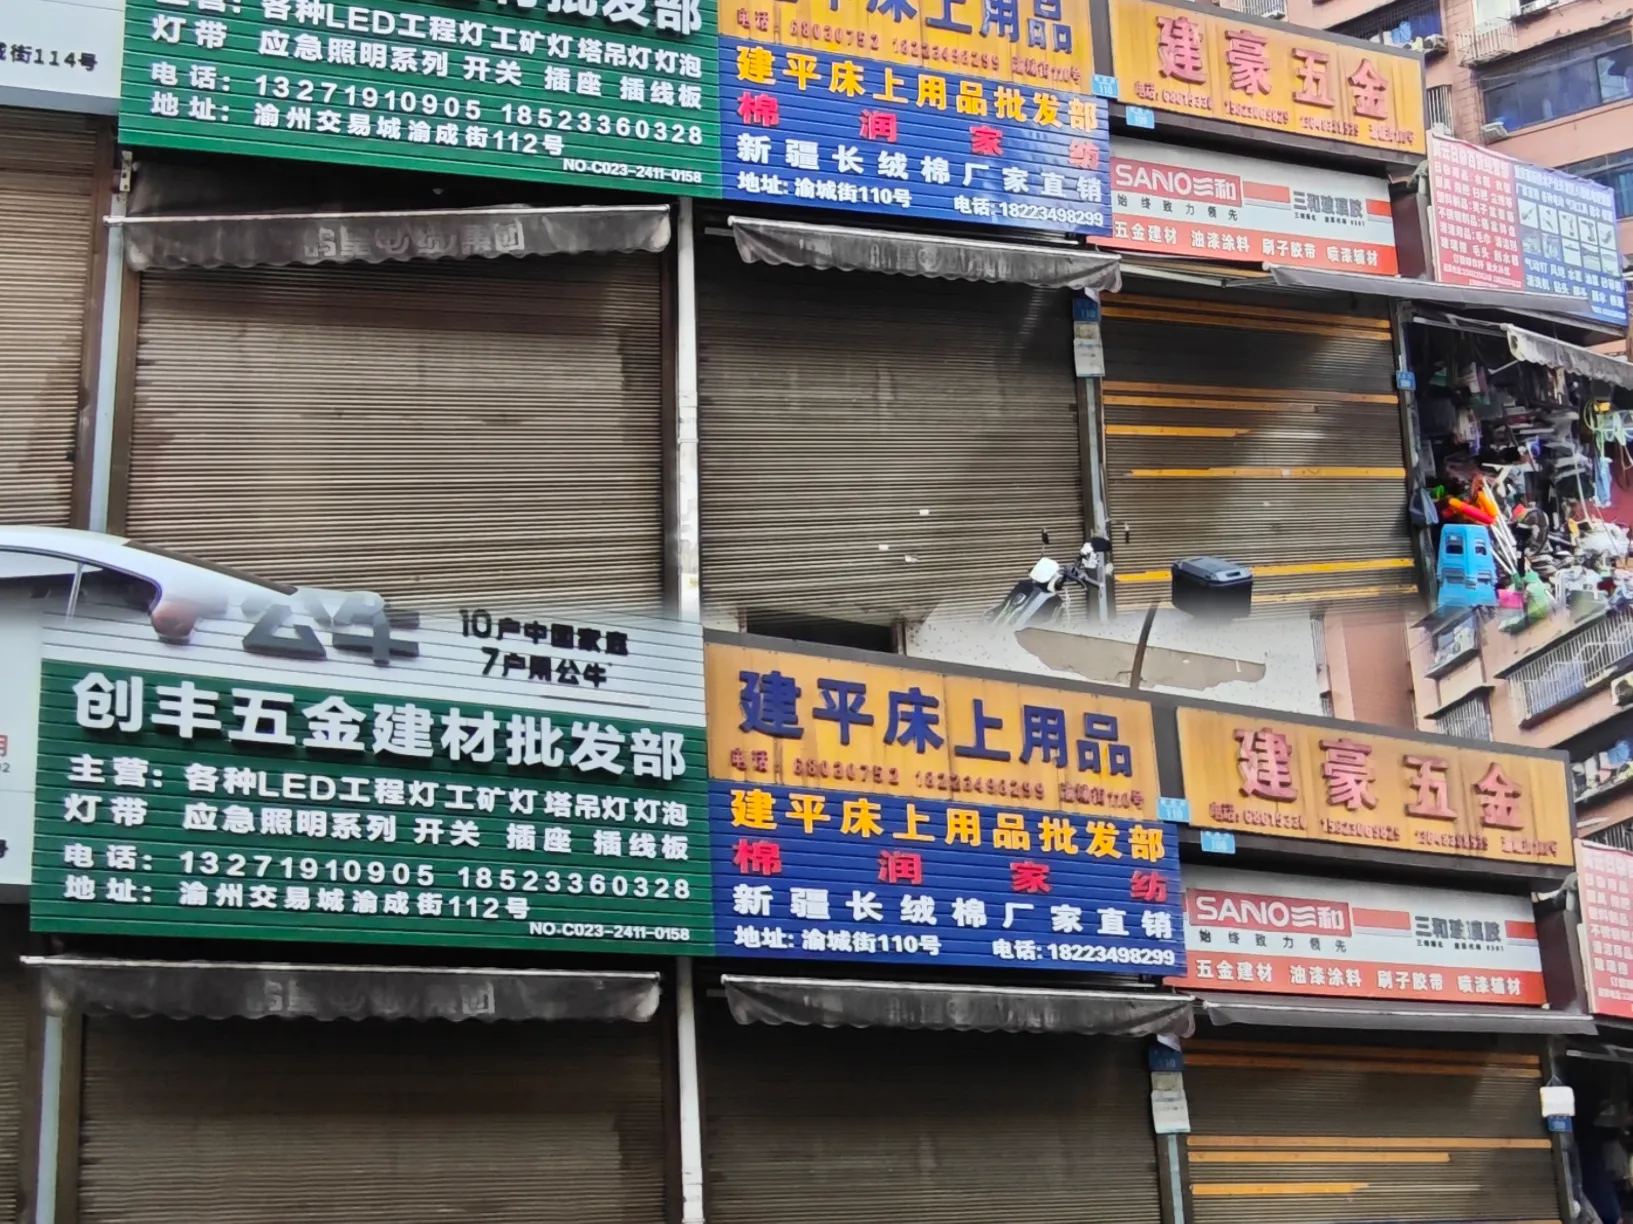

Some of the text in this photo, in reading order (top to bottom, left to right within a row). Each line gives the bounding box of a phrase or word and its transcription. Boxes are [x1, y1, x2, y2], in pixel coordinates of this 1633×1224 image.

[151, 13, 702, 110] 灯带 应急照明系列 开关 插座 插线板
[736, 45, 1099, 133] 建平床上用品批发部
[1156, 15, 1389, 121] 建豪五金
[254, 74, 481, 120] 13271910905
[501, 103, 703, 145] 18523360328
[254, 102, 565, 156] 渝州交易城渝成街112号
[737, 91, 1100, 170] 棉润家纺
[736, 133, 1103, 203] 新疆长绒棉厂家直销
[794, 176, 913, 208] 渝城街110号
[999, 202, 1104, 228] 18223498299
[1113, 220, 1178, 246] 五金建材
[1190, 229, 1250, 254] 油漆涂料
[1116, 194, 1239, 222] 始终致力领先
[72, 671, 687, 781] 创丰五金建材批发部
[737, 669, 1133, 777] 建平床上用品
[1233, 726, 1525, 831] 建豪五金
[63, 792, 689, 861] 灯带 应急照明系列 开关 插座 插线板
[730, 788, 1166, 863] 建平床上用品批发部
[179, 850, 435, 888] 13271910905
[457, 866, 690, 900] 18523360328
[179, 881, 531, 921] 渝州交易城渝成街112号
[731, 837, 1168, 904] 棉润家纺
[732, 883, 1174, 940] 新疆长绒棉厂家直销
[1198, 929, 1348, 954] 始终致力领先
[801, 927, 942, 956] 渝城街110号
[1046, 942, 1176, 968] 18223498299
[1196, 959, 1274, 984] 五金建材
[1289, 964, 1363, 989] 油漆涂料
